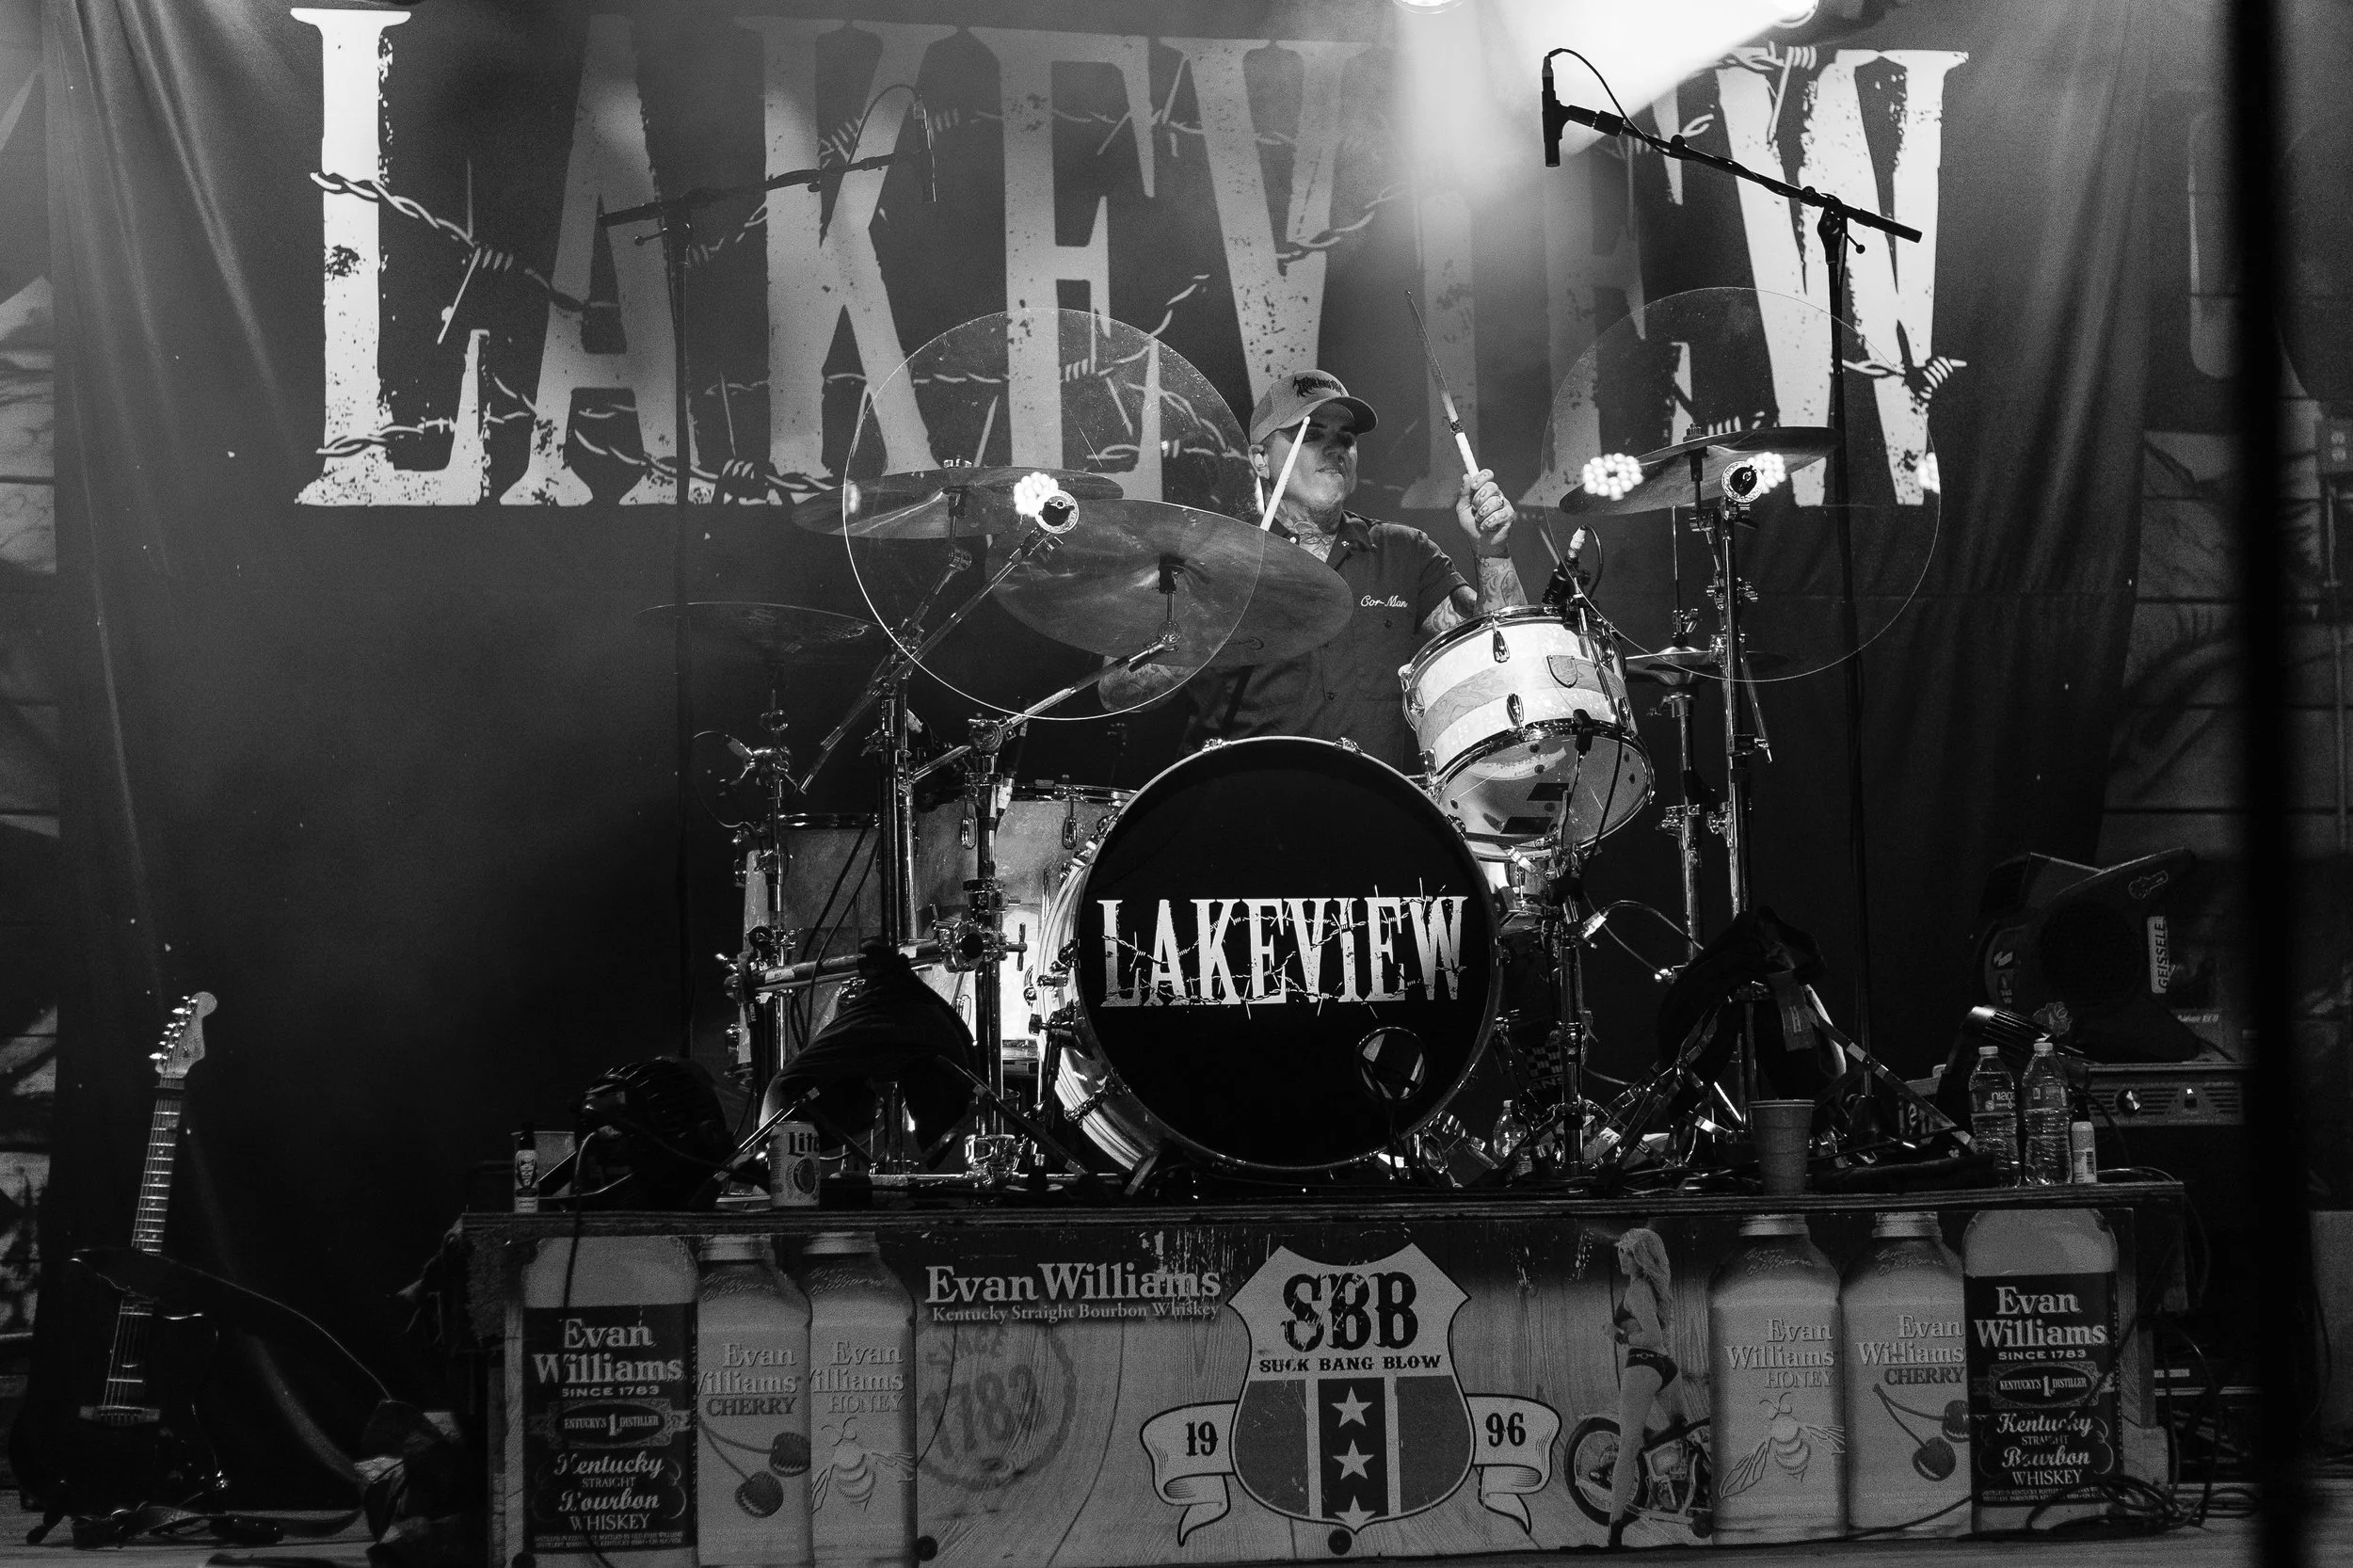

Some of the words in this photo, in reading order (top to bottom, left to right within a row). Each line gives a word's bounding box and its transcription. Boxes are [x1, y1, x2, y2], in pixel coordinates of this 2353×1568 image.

[291, 8, 1969, 509] LAKEVIEW
[1360, 595, 1408, 608] Cor-Man
[1096, 895, 1468, 1006] LAKEVIEW
[2154, 923, 2169, 988] GEISSELE
[933, 1306, 1007, 1324] Kentucky
[1012, 1304, 1074, 1322] Straight
[1080, 1304, 1147, 1319] Bourbon
[1152, 1301, 1219, 1319] Whiskey
[1280, 1272, 1418, 1352] SBB
[1995, 1286, 2082, 1315] Evan
[564, 1318, 656, 1349] Evan
[1766, 1319, 1833, 1342] Evan
[1897, 1314, 1964, 1339] Evan
[1973, 1318, 2109, 1348] Williams
[723, 1343, 797, 1368] Evan
[830, 1341, 905, 1366] Evan
[1258, 1358, 1310, 1373] SUCK
[1320, 1356, 1375, 1371] BANG
[1383, 1354, 1442, 1368] BLOW
[1725, 1345, 1834, 1369] Williams
[1856, 1341, 1965, 1366] Williams
[1997, 1350, 2047, 1361] SINCE
[2050, 1349, 2088, 1360] 1783
[532, 1352, 683, 1384] Williams
[1764, 1370, 1834, 1389] HONEY
[1883, 1367, 1965, 1386] CHERRY
[562, 1386, 615, 1398] SINCE
[619, 1385, 660, 1397] 1783
[706, 1397, 797, 1416] CHERRY
[827, 1394, 905, 1414] HONEY
[564, 1416, 607, 1430] ENTUCKY'S
[1485, 1412, 1527, 1448] 96
[1185, 1420, 1219, 1457] 19
[582, 1477, 636, 1488] STRAIGHT
[2012, 1468, 2083, 1486] WHISKEY
[568, 1512, 651, 1532] WHISKEY
